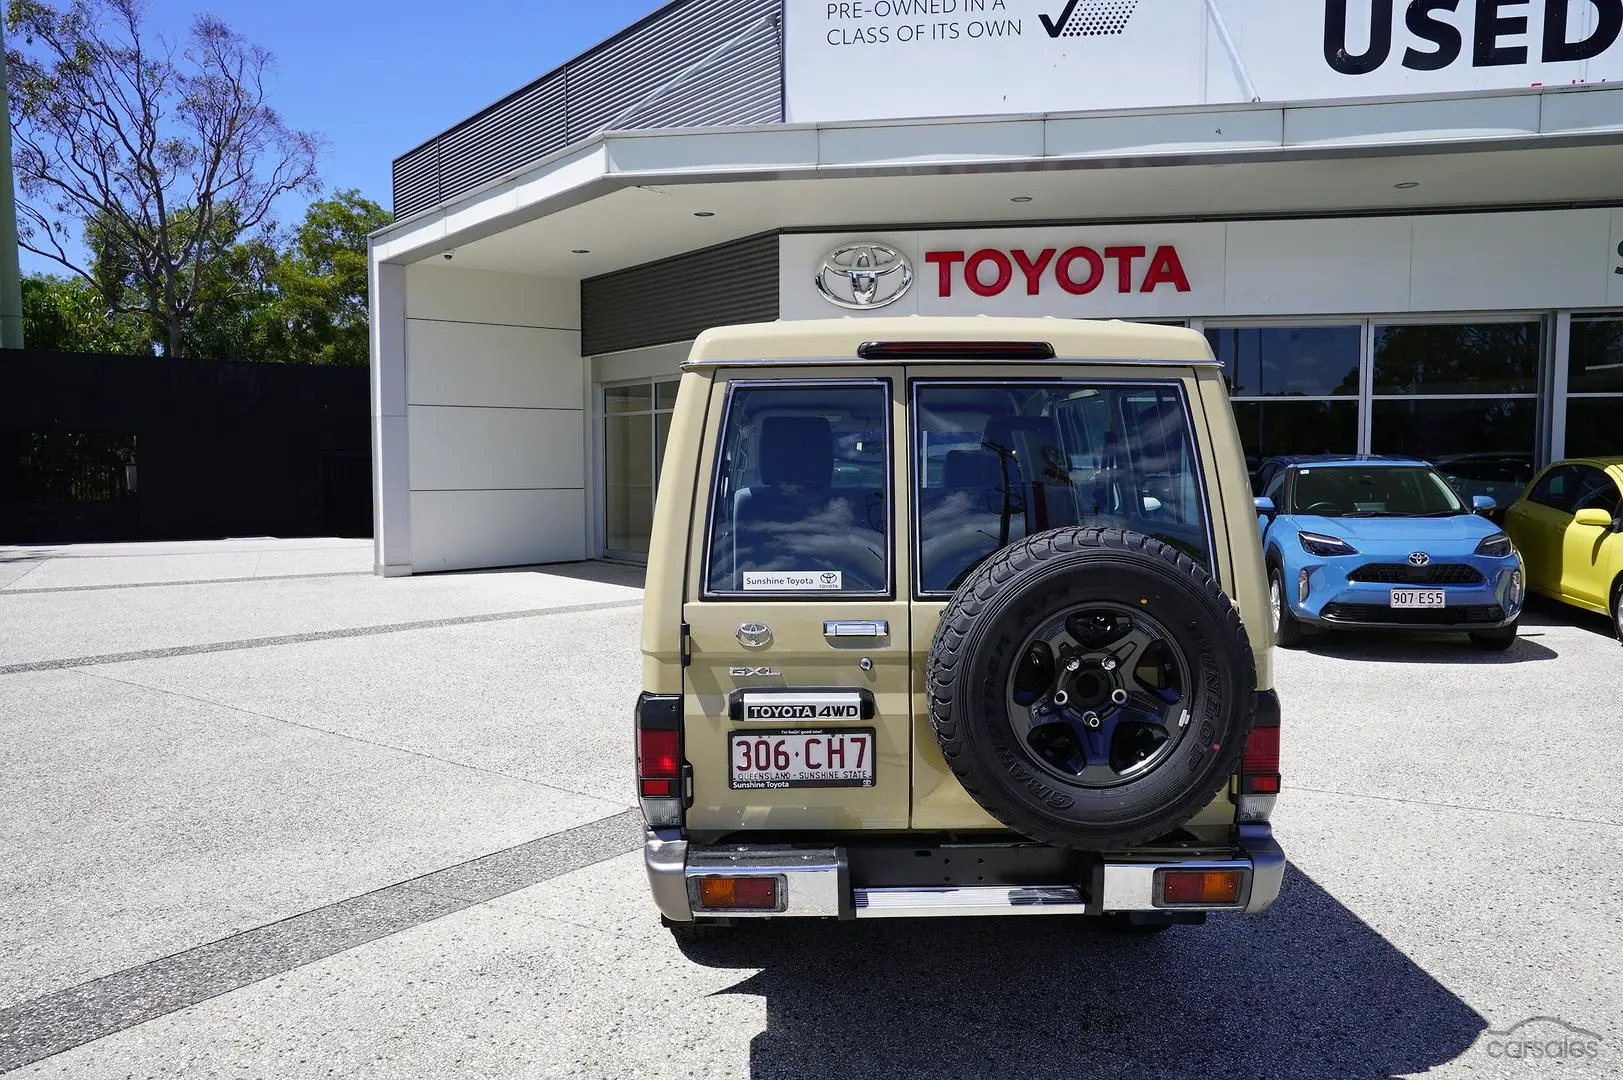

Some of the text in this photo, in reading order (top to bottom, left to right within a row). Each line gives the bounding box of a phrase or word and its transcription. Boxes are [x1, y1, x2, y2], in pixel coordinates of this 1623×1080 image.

[827, 0, 957, 20] PRE-OWNED
[964, 0, 985, 12] IN
[826, 20, 1022, 46] CLASS OF ITS OWN
[1324, 0, 1623, 75] USED
[925, 245, 1191, 298] TOYOTA
[746, 577, 814, 586] Sunshine Toyota
[729, 666, 782, 677] GXL
[750, 705, 858, 718] TOYOTA 4WD
[738, 772, 790, 780] QUEENSLAND
[799, 771, 839, 779] SUNSHINE
[843, 770, 867, 779] STATE
[766, 781, 789, 789] Toyota
